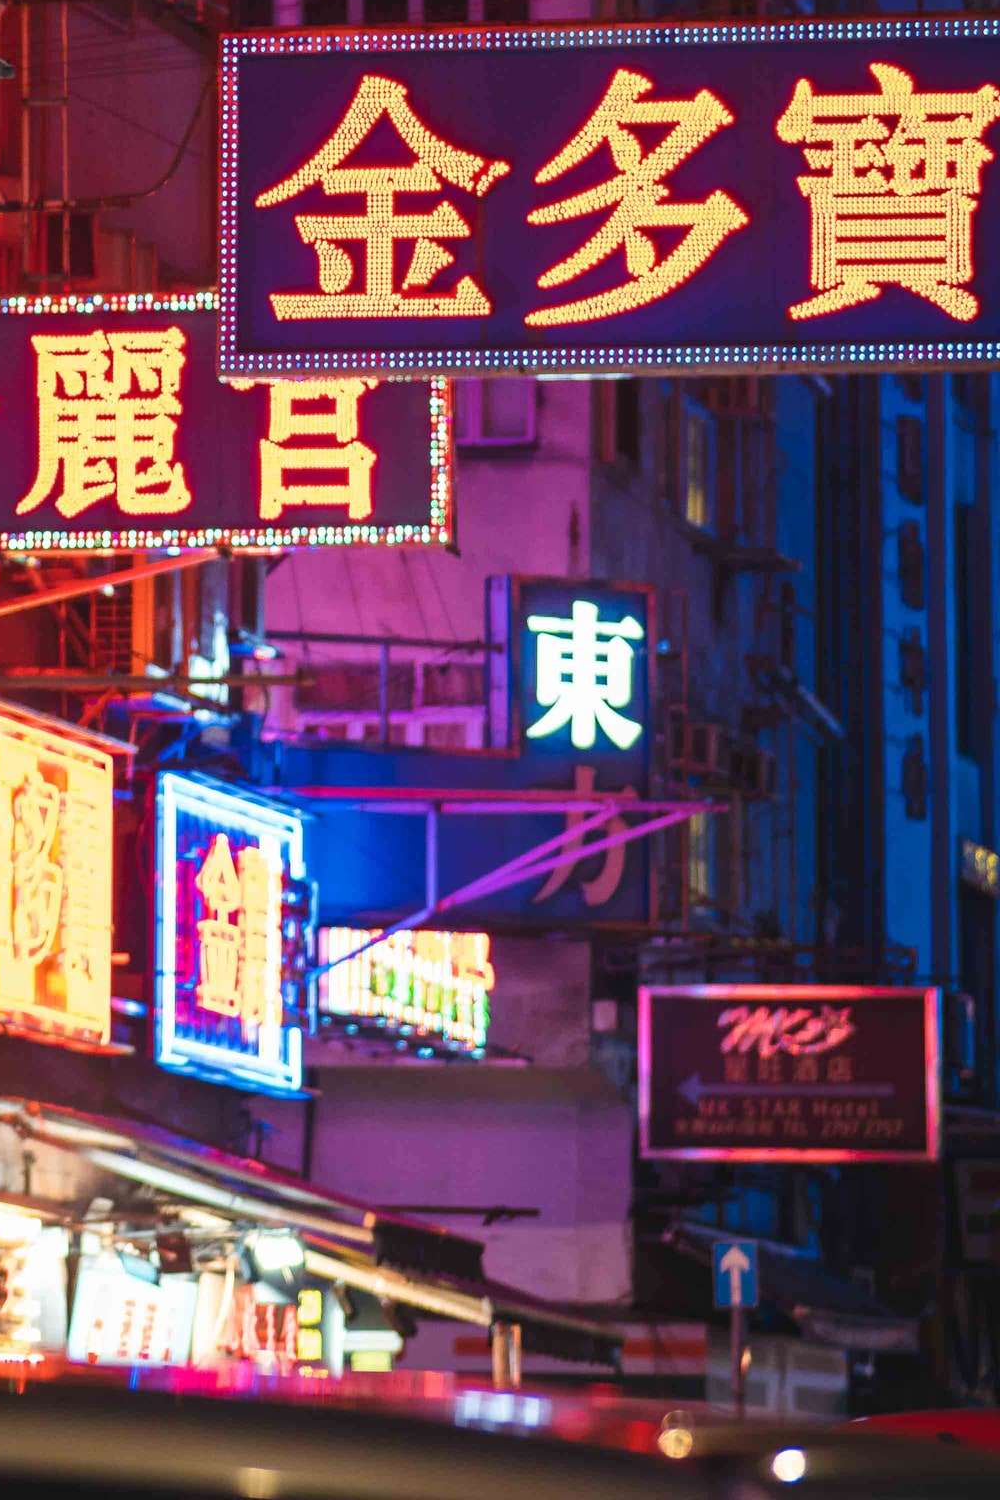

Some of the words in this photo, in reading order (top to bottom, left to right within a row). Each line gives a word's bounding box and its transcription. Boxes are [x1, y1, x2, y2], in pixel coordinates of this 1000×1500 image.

[255, 63, 1000, 327] 金多寶
[743, 1098, 802, 1117] STAR
